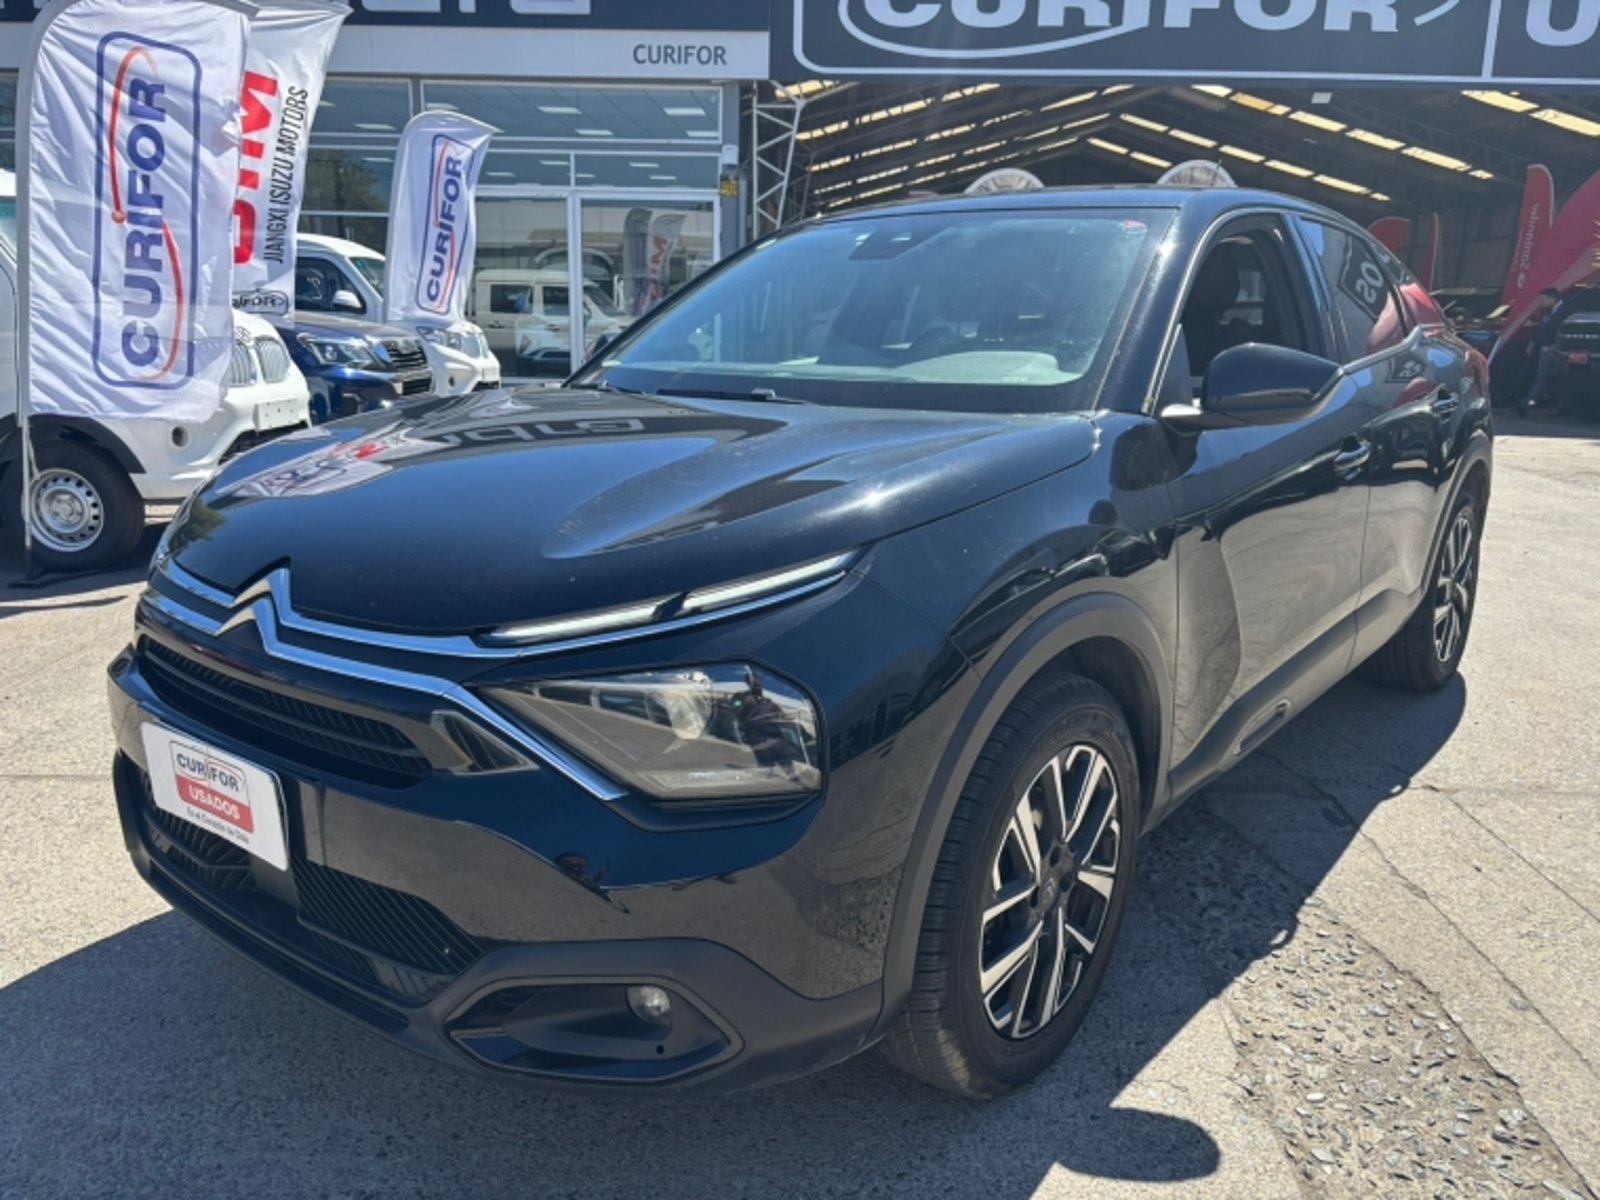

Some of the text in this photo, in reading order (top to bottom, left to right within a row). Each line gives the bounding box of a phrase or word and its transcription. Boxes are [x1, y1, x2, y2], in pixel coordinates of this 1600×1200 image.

[633, 44, 727, 66] CURIFOR
[263, 86, 308, 264] JIANGXI ISUZU MOTORS
[121, 77, 165, 367] CURIFOR
[427, 157, 463, 302] CURIFOR
[176, 753, 239, 792] CURIFOR
[189, 784, 240, 820] USADOS
